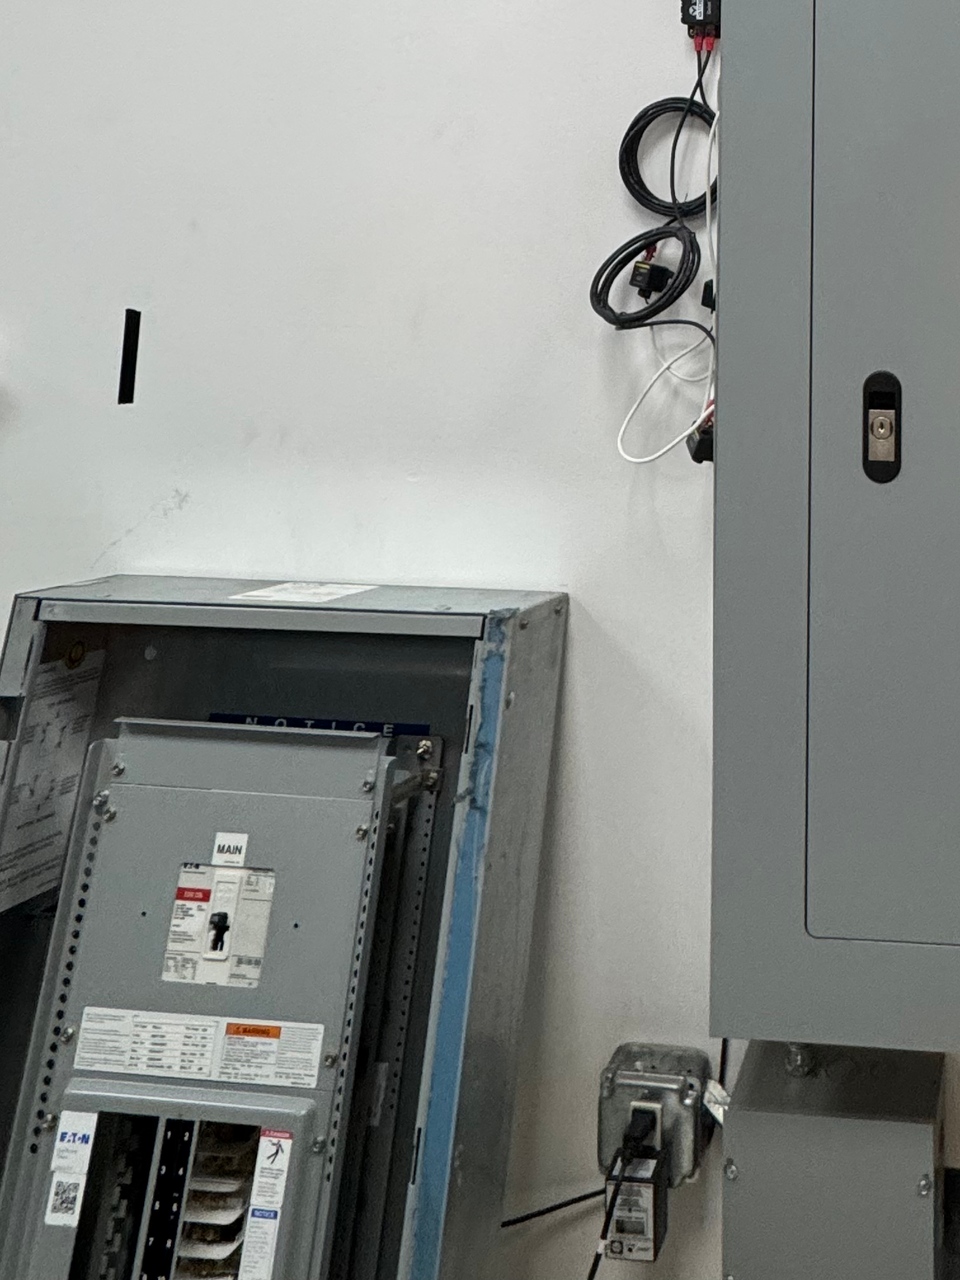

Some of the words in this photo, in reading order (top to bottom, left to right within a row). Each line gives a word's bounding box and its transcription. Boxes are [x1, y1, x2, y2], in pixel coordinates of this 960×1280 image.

[217, 844, 242, 855] MAIN
[60, 1131, 90, 1144] EATON
[167, 1131, 171, 1139] 1
[184, 1132, 189, 1141] 2
[161, 1165, 166, 1174] 3
[178, 1167, 183, 1175] 4
[149, 1237, 154, 1246] 7
